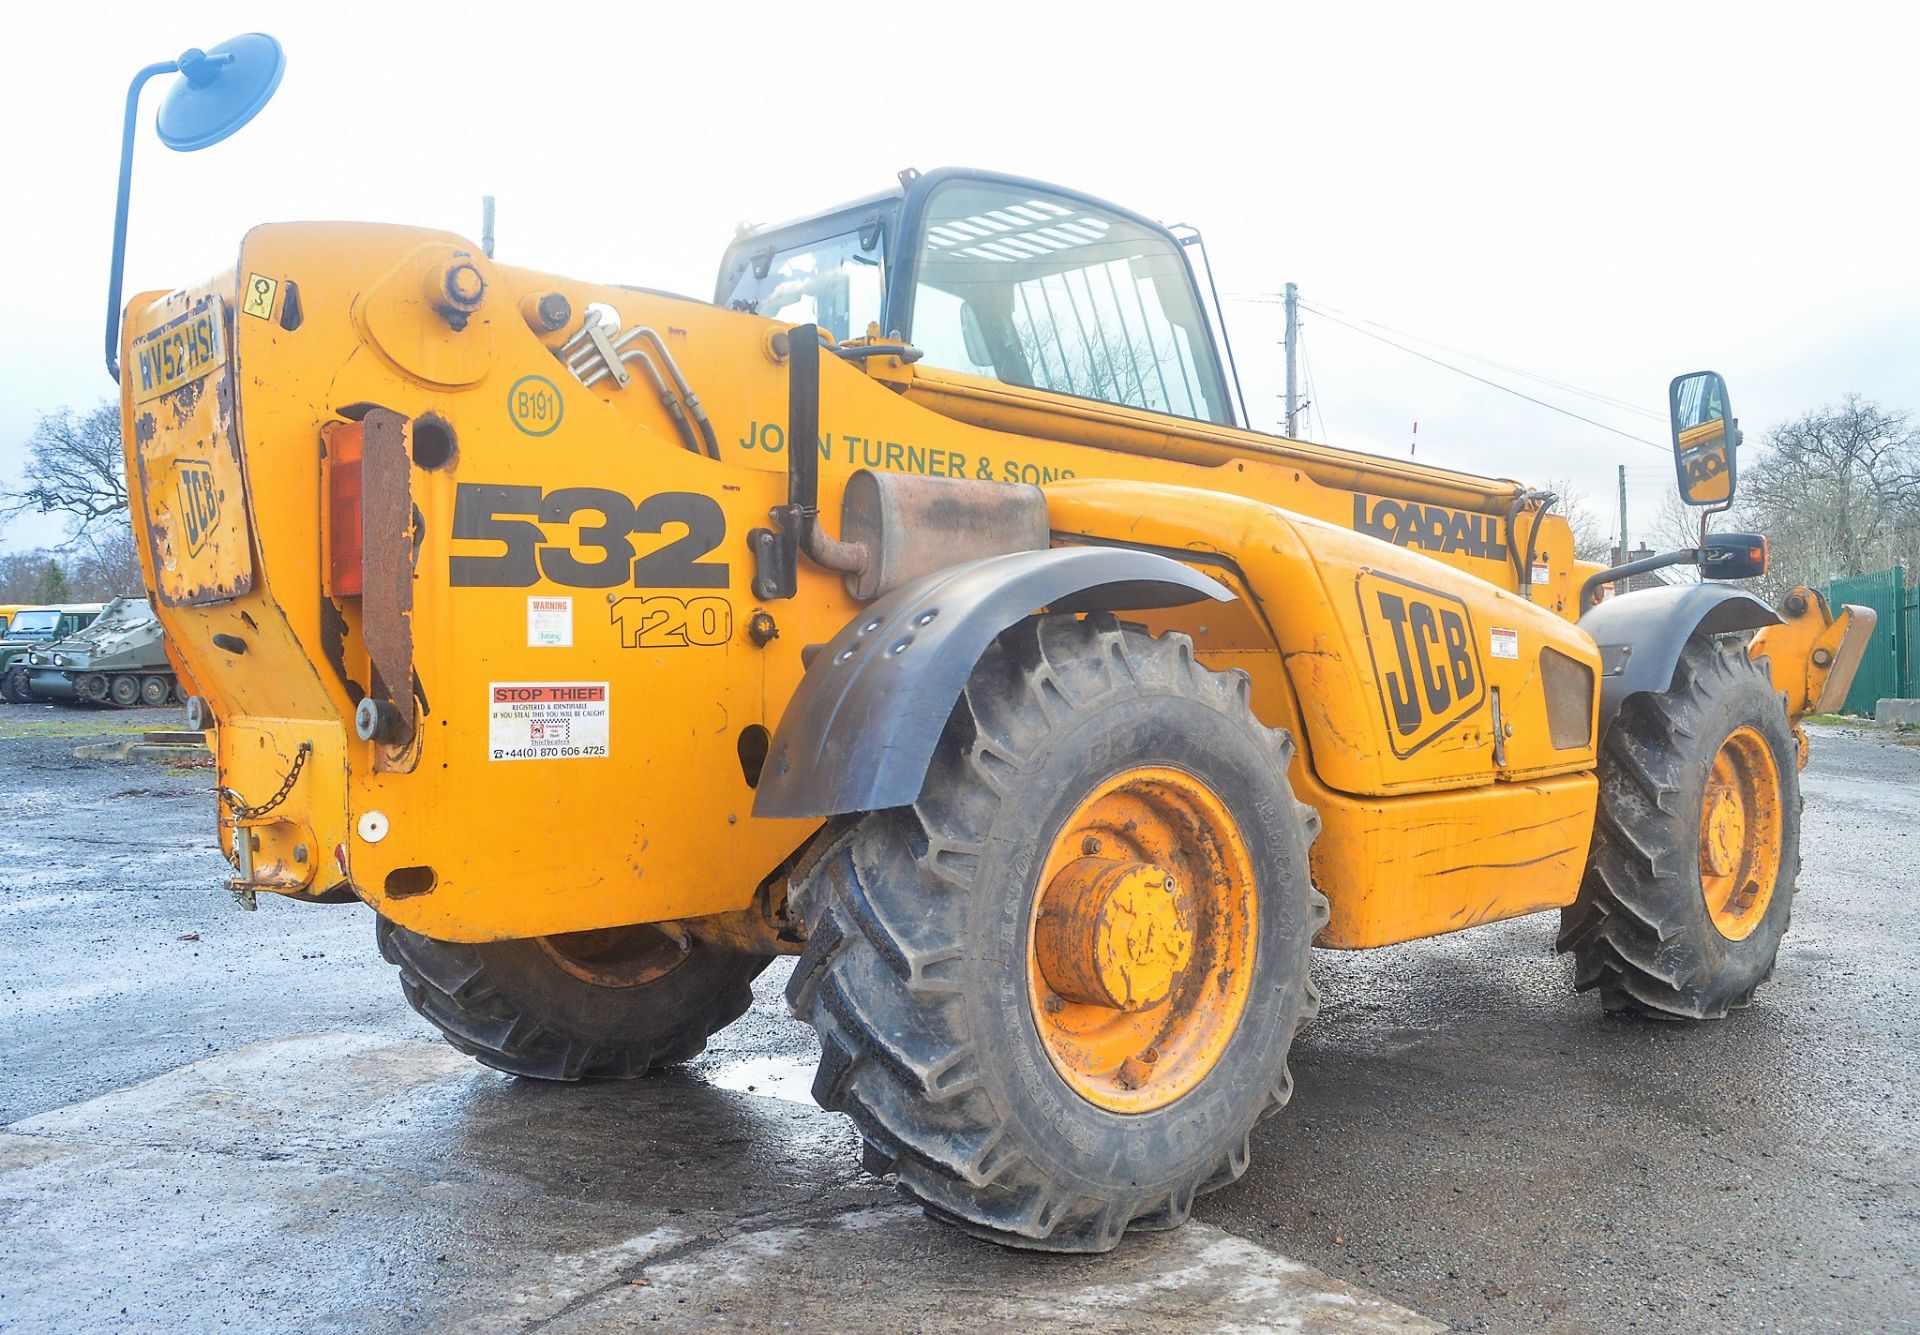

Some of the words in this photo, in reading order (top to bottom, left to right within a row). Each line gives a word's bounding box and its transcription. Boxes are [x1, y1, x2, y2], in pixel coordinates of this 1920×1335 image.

[518, 390, 554, 420] B191
[739, 421, 832, 461] JON
[842, 435, 967, 479] TURNER
[975, 456, 994, 480] &
[180, 469, 217, 546] JCB
[448, 482, 730, 589] 532
[1353, 493, 1508, 562] LOADALL
[532, 601, 568, 610] WARNING
[610, 596, 733, 649] 120
[1376, 590, 1476, 737] JCB
[495, 688, 543, 701] STOP
[549, 687, 604, 700] THIEF!
[505, 748, 537, 758] +44(0)
[540, 747, 558, 757] 870
[560, 747, 580, 756] 606
[582, 746, 606, 755] 4725
